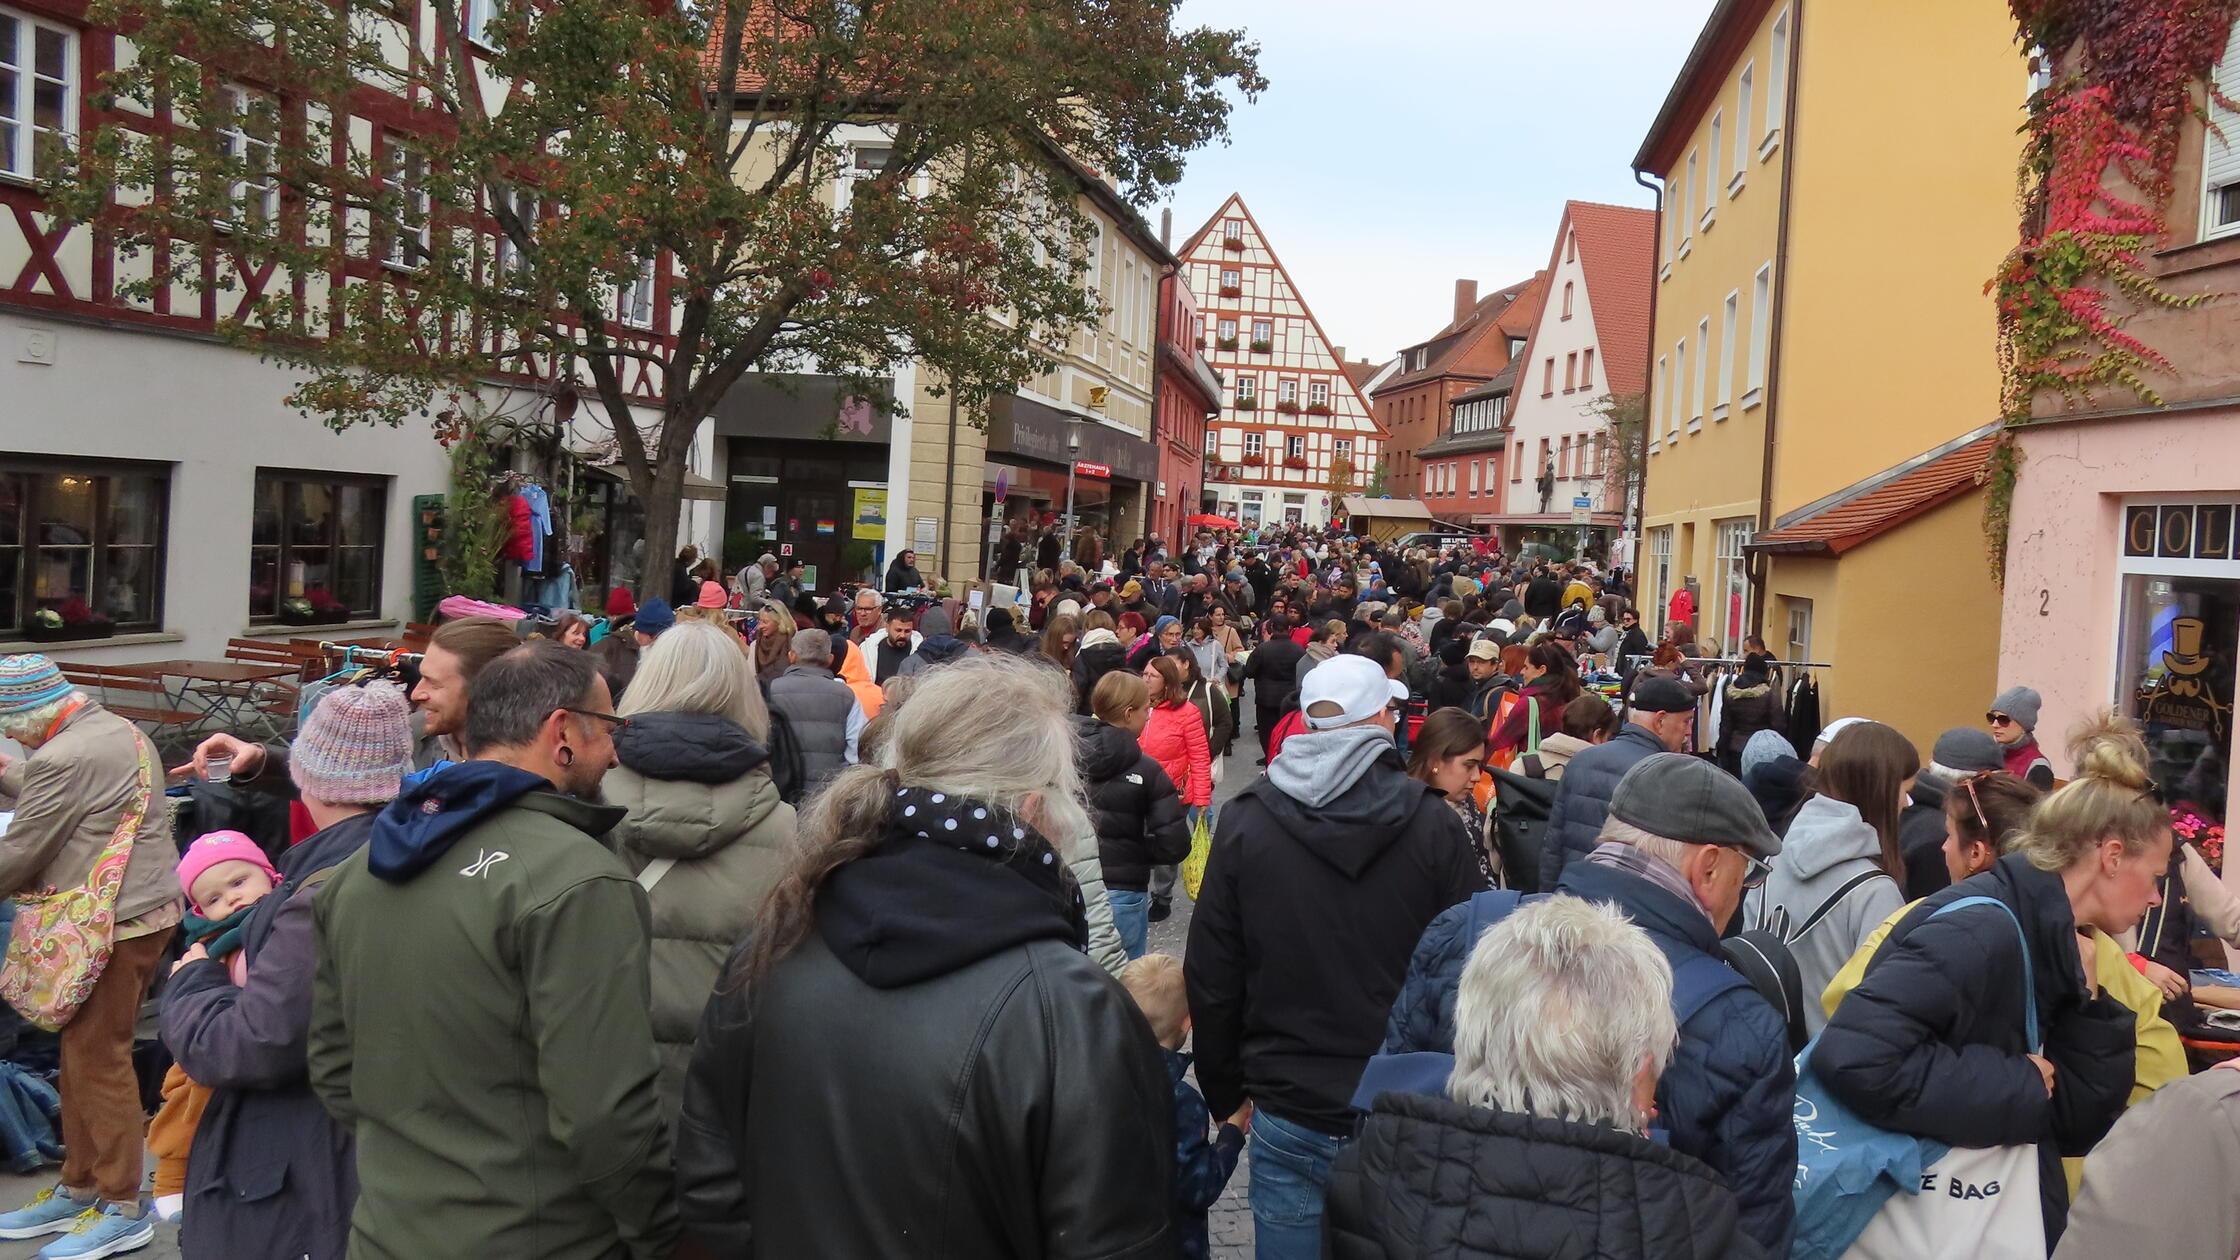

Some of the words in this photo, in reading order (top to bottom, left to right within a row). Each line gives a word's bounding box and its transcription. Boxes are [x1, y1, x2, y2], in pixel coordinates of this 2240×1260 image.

[2130, 510, 2240, 555] GOL
[2040, 589, 2049, 616] 2
[2155, 702, 2209, 721] GOLDENER
[1949, 1177, 2001, 1200] BAG
